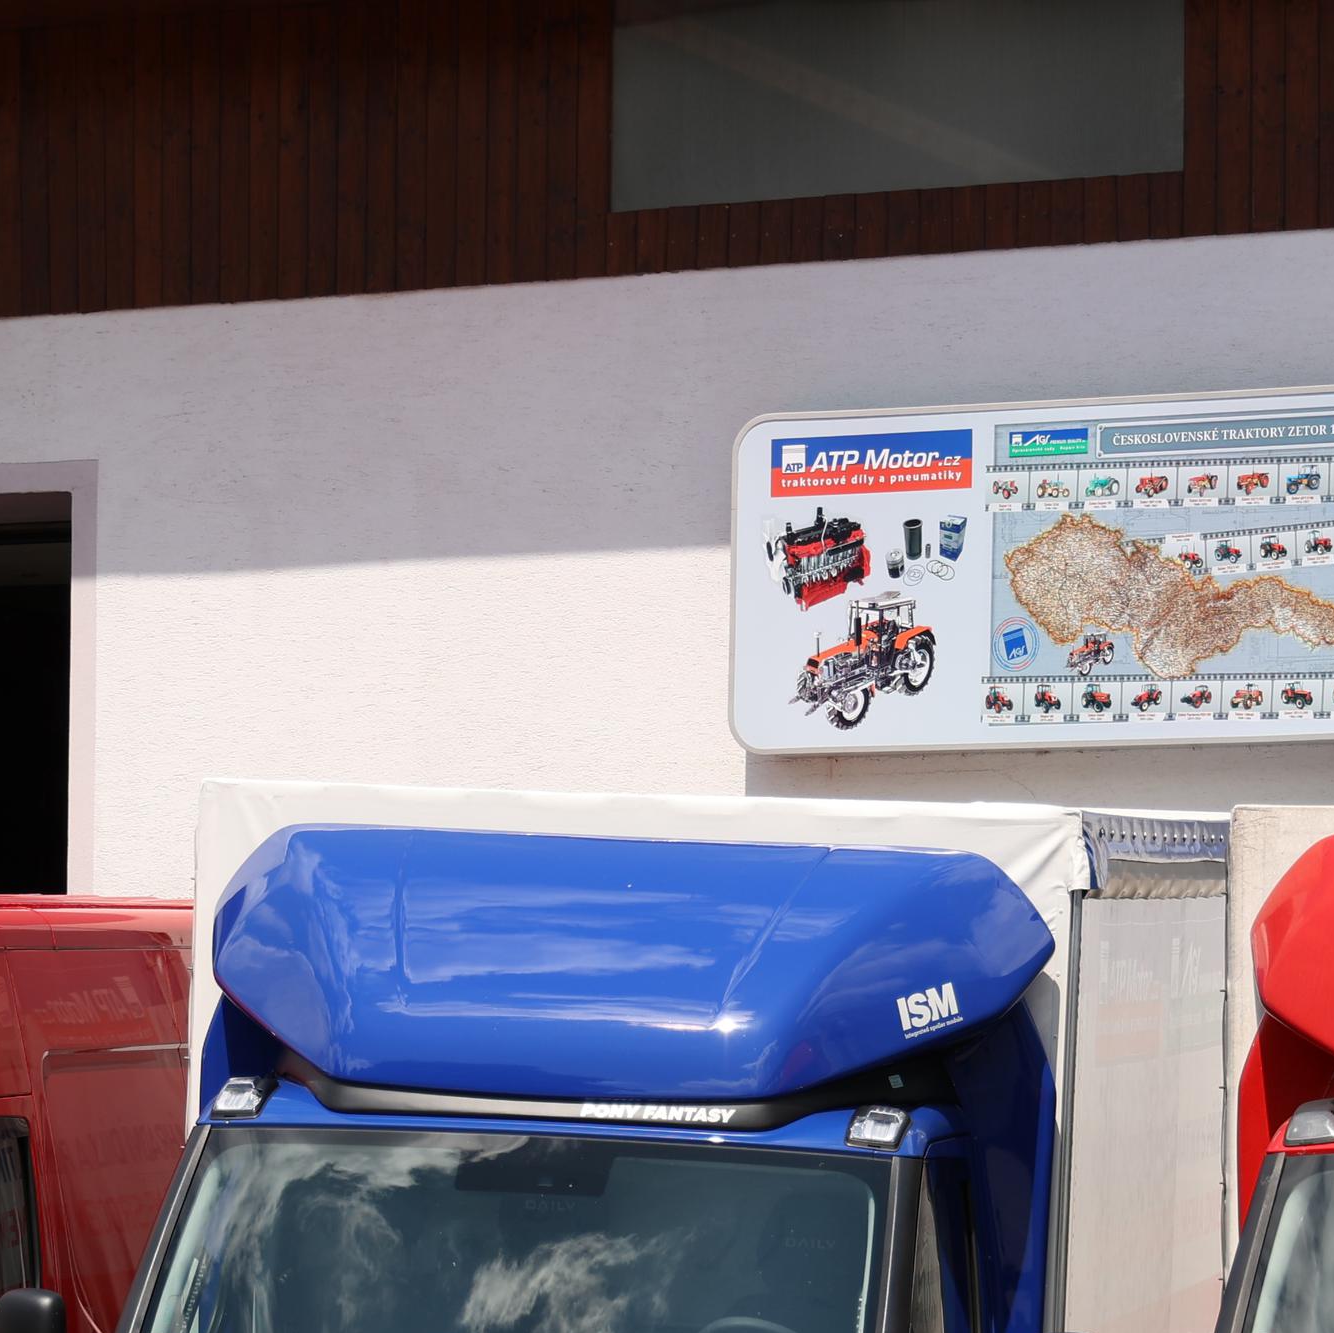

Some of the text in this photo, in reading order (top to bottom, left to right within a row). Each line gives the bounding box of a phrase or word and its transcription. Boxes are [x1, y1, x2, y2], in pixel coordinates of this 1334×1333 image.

[1113, 427, 1219, 446] ČESKOSLOVENSKÉ
[1221, 426, 1285, 440] TRAKTORY
[1288, 424, 1327, 437] ZETOR
[784, 462, 803, 472] ATP
[811, 448, 961, 472] ATP Motor.cz
[781, 475, 847, 488] traktorové
[851, 474, 875, 486] díly
[890, 470, 961, 486] pneumatiky
[897, 982, 959, 1031] ISM
[579, 1102, 736, 1123] PONY FANTASY
